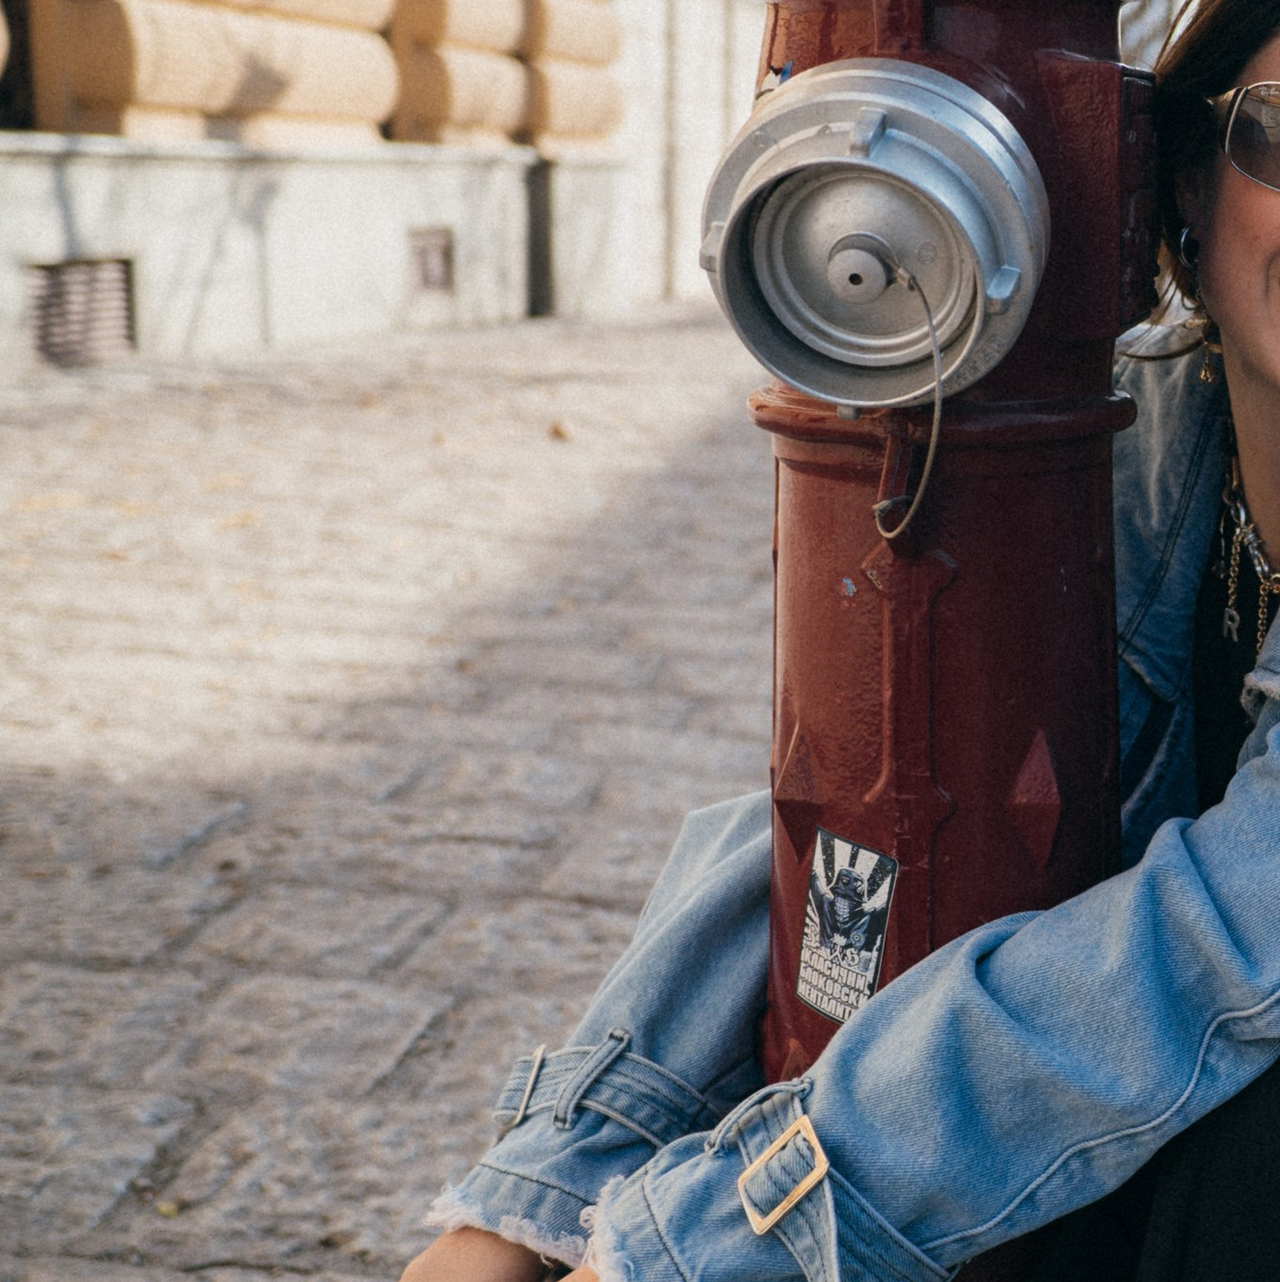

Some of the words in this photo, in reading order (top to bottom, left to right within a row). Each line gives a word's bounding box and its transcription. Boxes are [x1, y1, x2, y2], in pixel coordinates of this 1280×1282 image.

[1223, 608, 1240, 642] R
[804, 946, 867, 992] КЛАСИЧНИ
[798, 979, 854, 1022] МЕНТАЛИТ
